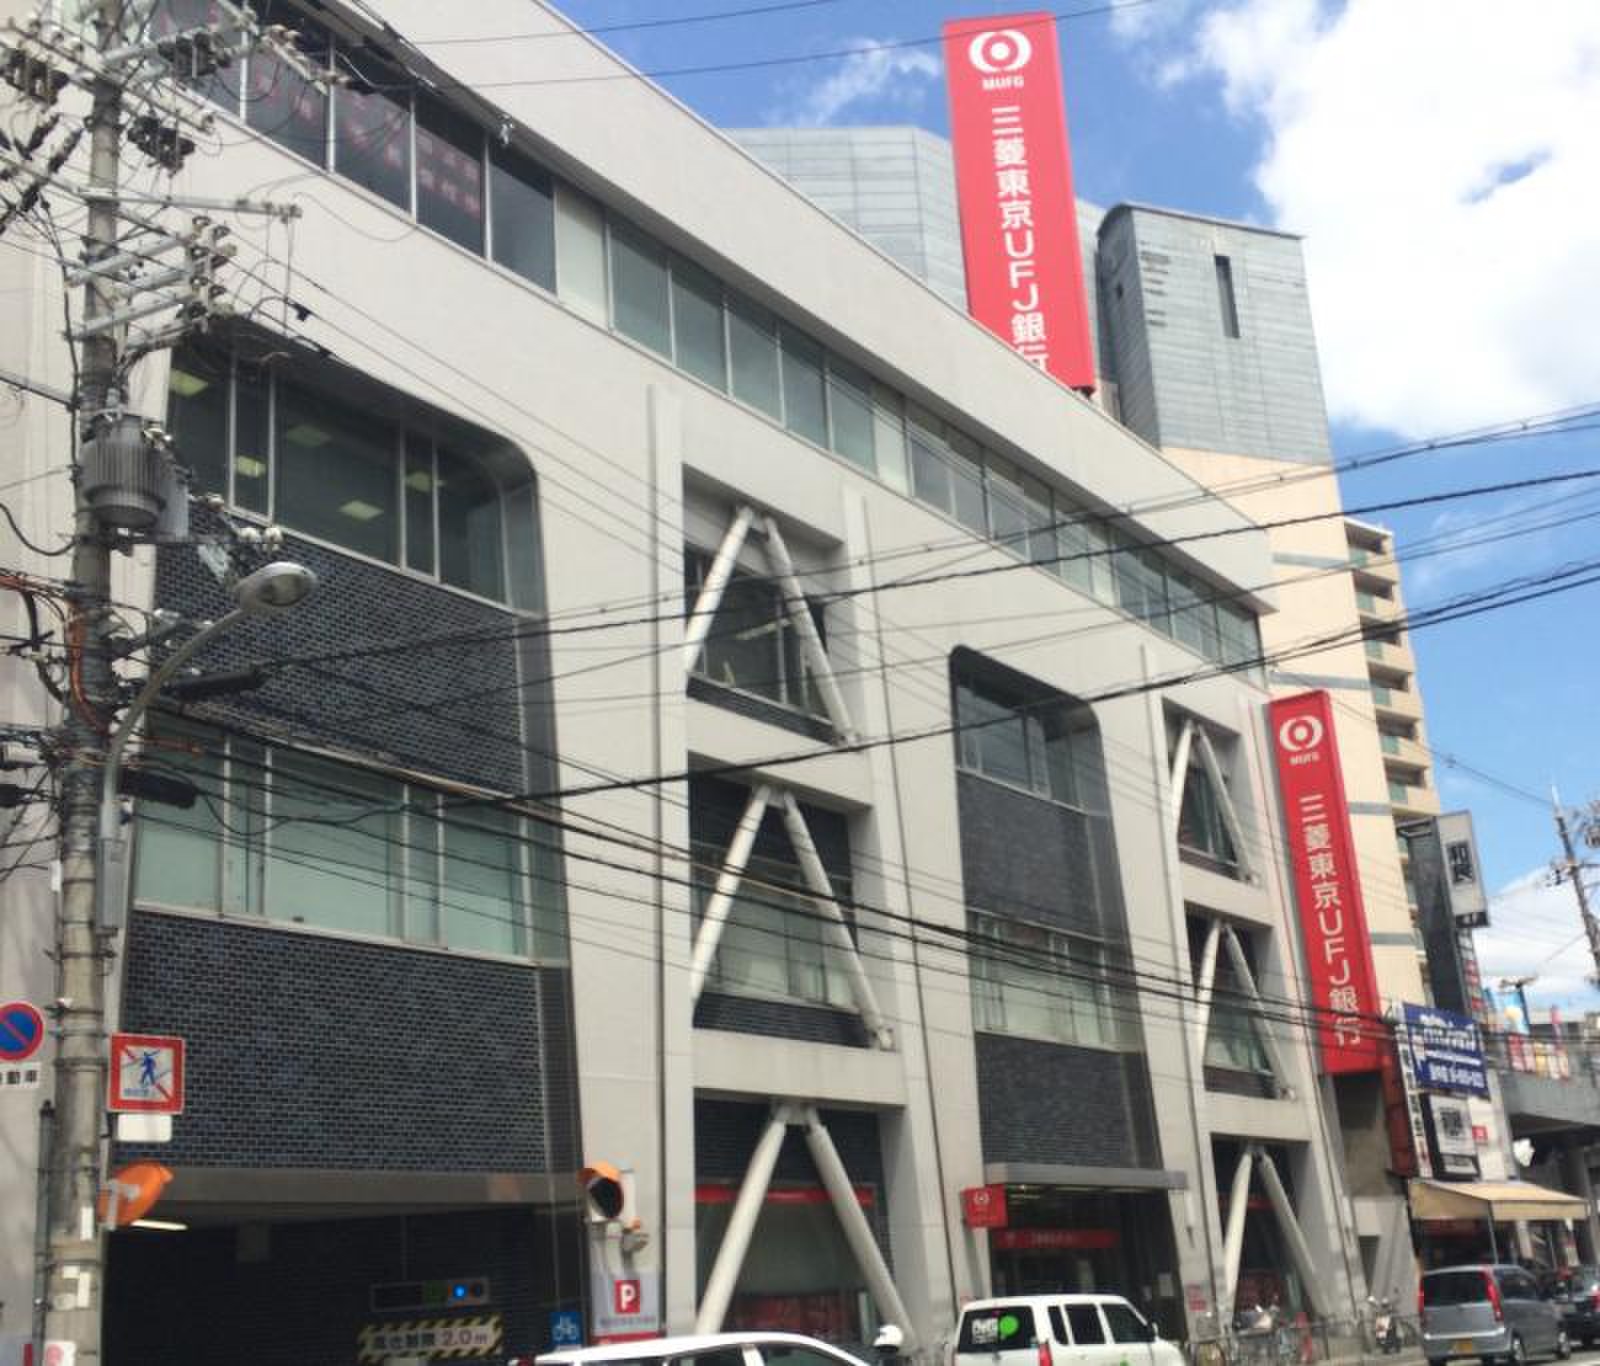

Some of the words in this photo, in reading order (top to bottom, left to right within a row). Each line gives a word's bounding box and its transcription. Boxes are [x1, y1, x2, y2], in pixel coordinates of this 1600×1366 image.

[982, 76, 1025, 91] MUFG
[1299, 793, 1361, 1047] 三菱東京UFJ銀行
[621, 1284, 636, 1310] P
